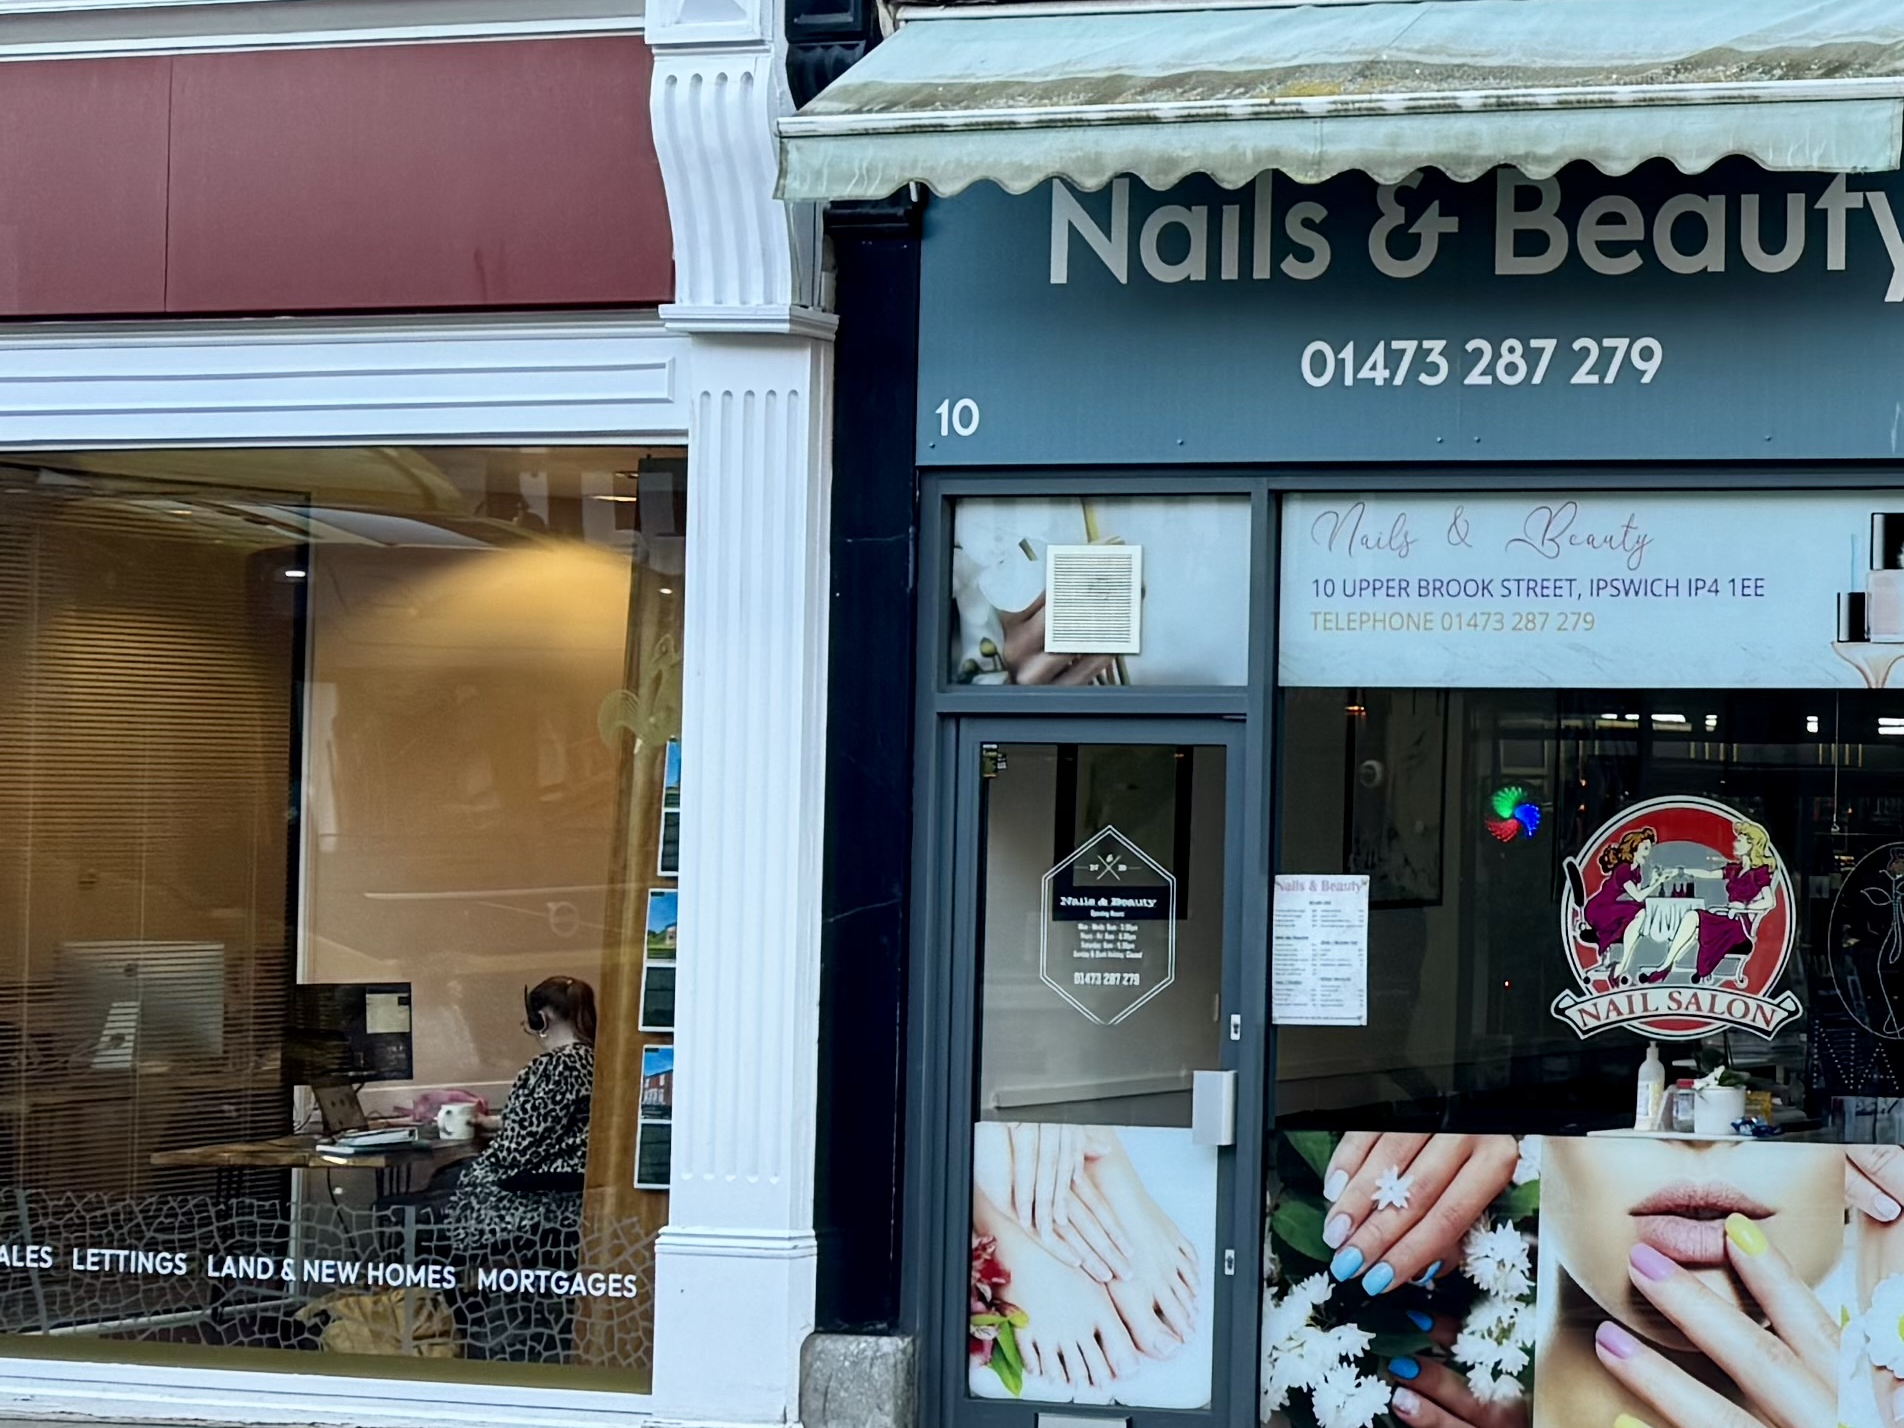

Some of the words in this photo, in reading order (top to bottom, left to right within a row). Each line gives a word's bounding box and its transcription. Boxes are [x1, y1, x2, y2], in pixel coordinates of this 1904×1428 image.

[1050, 170, 1331, 285] Nails
[1368, 171, 1460, 278] &
[1302, 338, 1448, 388] 01473
[1463, 337, 1558, 386] 287
[1569, 335, 1664, 385] 279
[935, 398, 980, 438] 10
[1310, 501, 1417, 558] Nails
[1446, 505, 1473, 549] &
[1505, 500, 1655, 571] Beauty
[1311, 578, 1336, 598] 10
[1343, 578, 1410, 598] UPPER
[1418, 578, 1494, 599] BROOK
[1500, 578, 1583, 601] STREET,
[1589, 578, 1680, 599] IPSWICH
[1688, 578, 1720, 598] IP4
[1727, 578, 1765, 598] 1EE
[1310, 611, 1434, 632] TELEPHONE
[1441, 612, 1505, 632] 01473
[1511, 612, 1549, 632] 287
[1556, 612, 1595, 632] 279
[1060, 896, 1096, 906] Nails
[1073, 972, 1101, 985] 01473
[1103, 972, 1121, 985] 287
[1122, 973, 1140, 986] 279
[1577, 991, 1660, 1028] NAIL
[1667, 990, 1777, 1029] SALON
[72, 1247, 187, 1276] LETTINGS
[207, 1254, 274, 1280] LAND
[280, 1259, 296, 1282] &
[302, 1259, 360, 1284] NEW
[366, 1262, 457, 1290] HOMES
[478, 1266, 638, 1298] MORTGAGES
